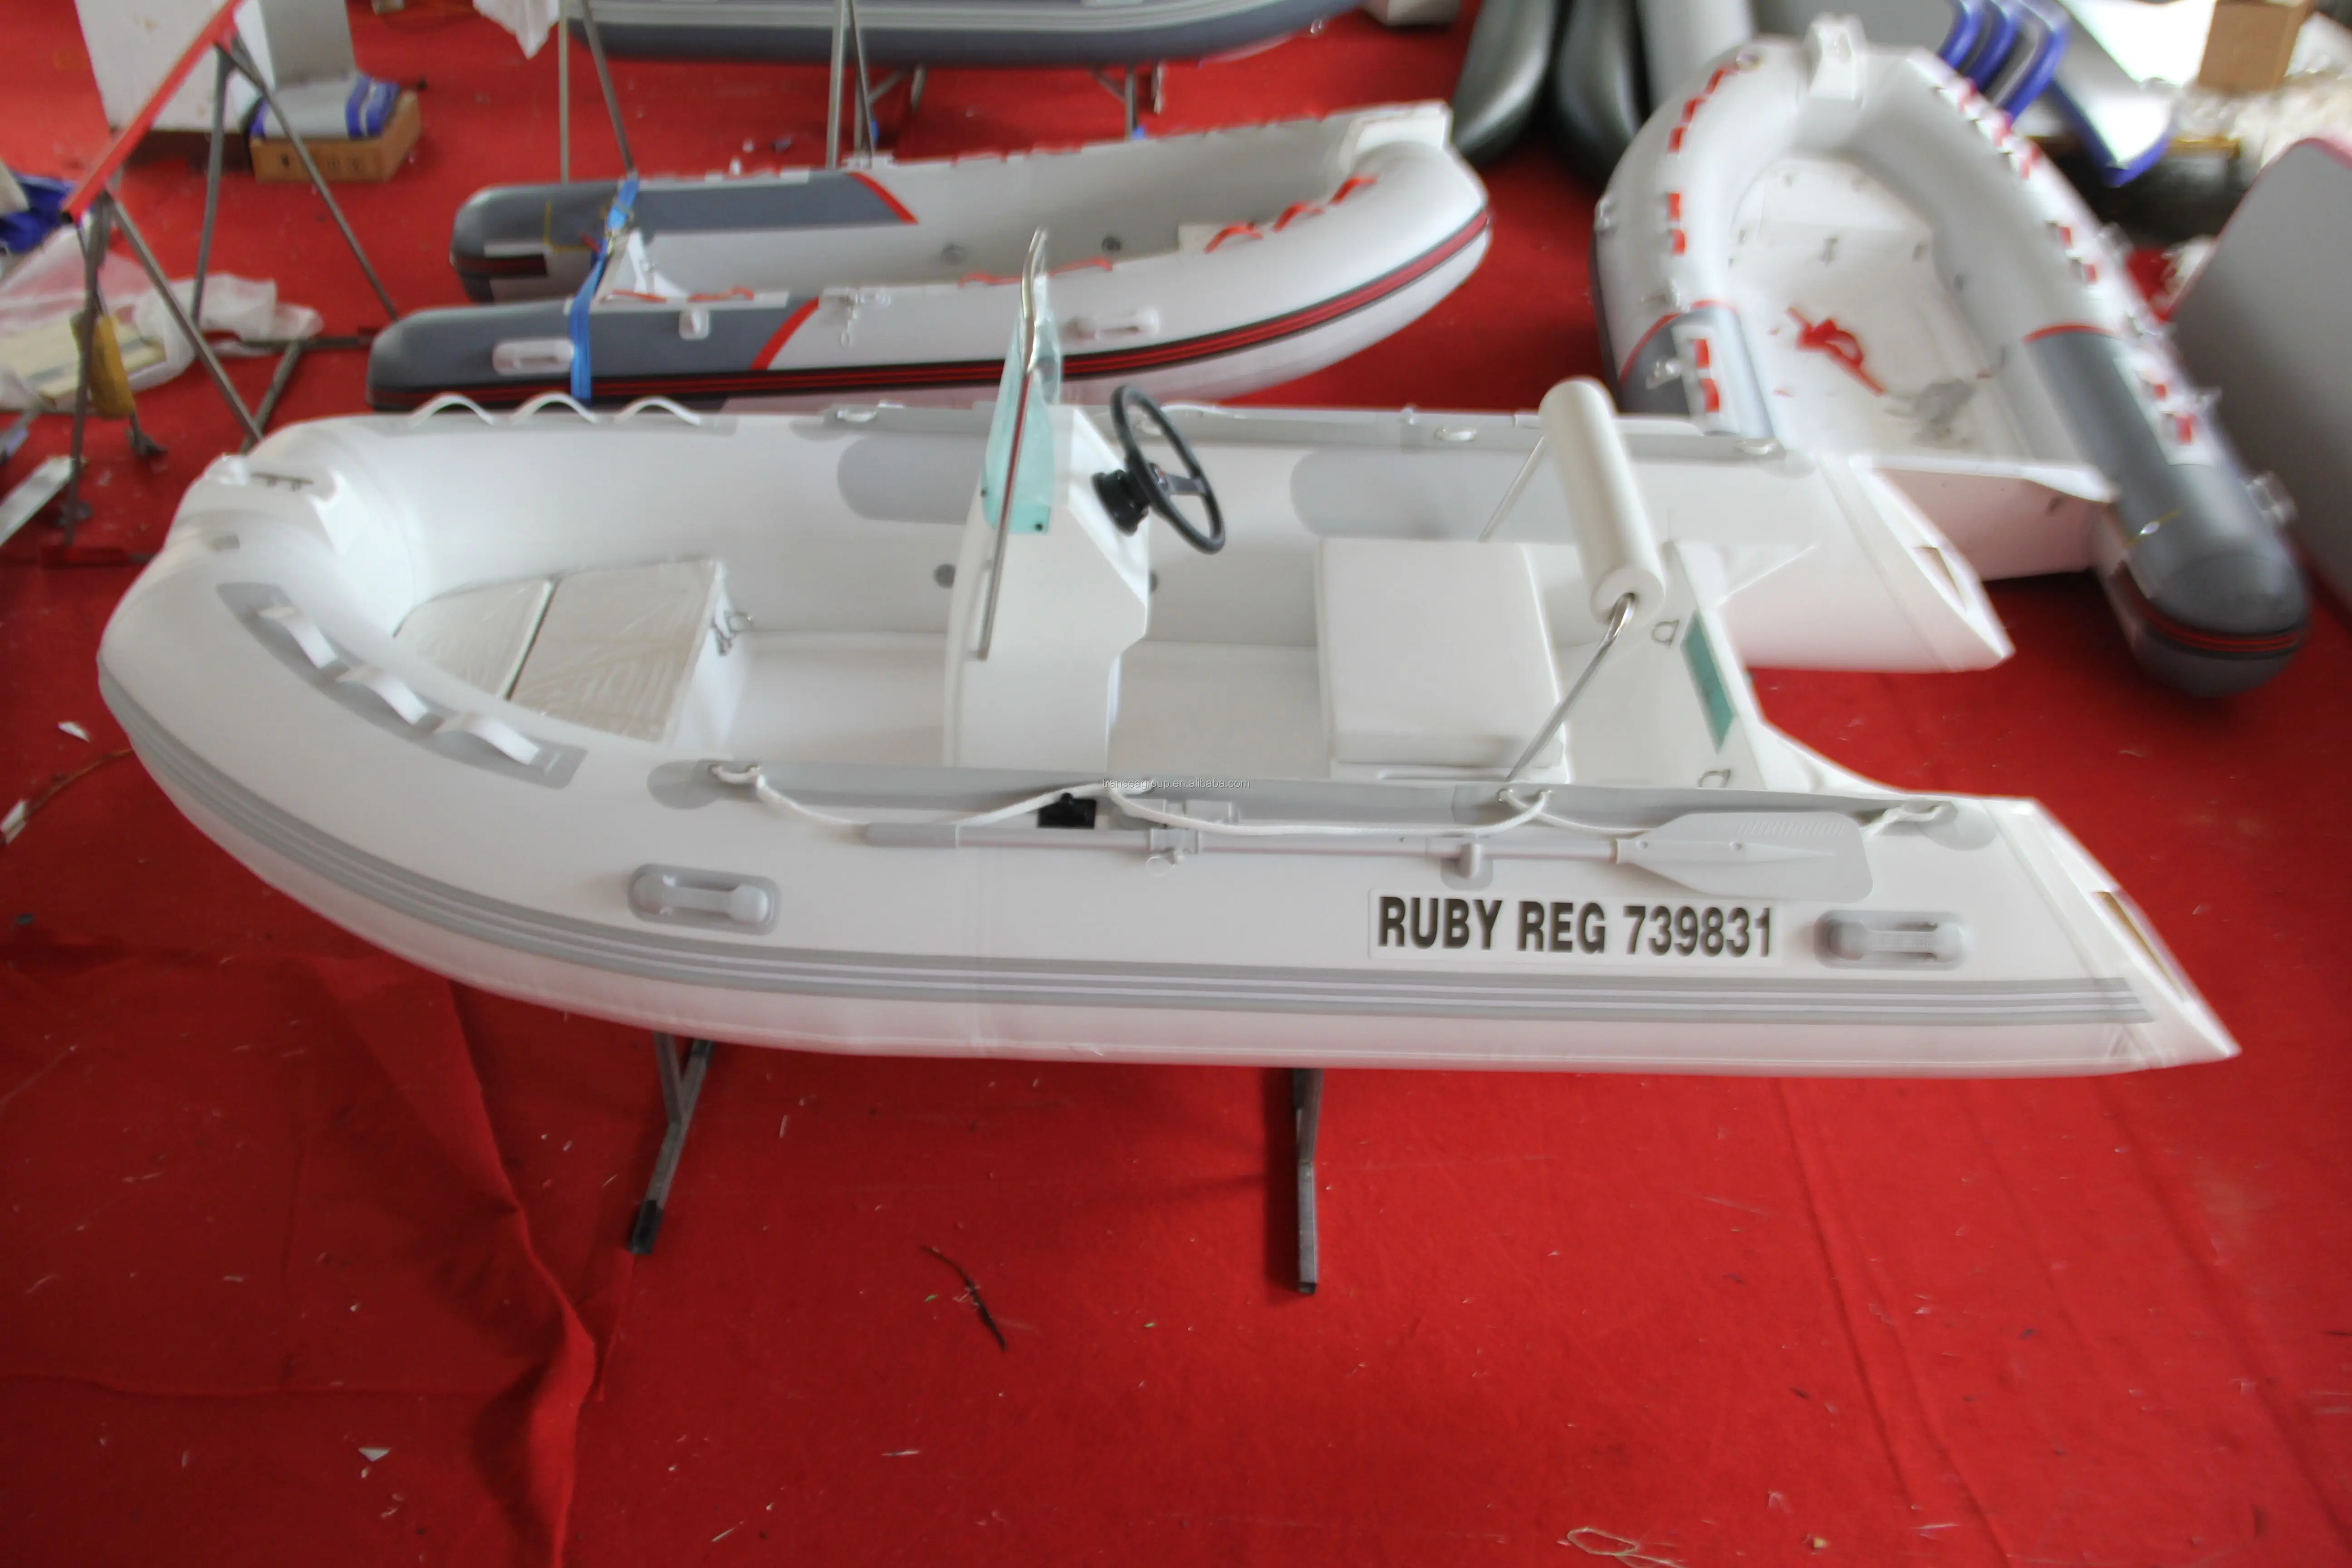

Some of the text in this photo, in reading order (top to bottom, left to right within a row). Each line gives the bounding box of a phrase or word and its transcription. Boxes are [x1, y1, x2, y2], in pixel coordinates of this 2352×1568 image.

[1378, 896, 1771, 957] RUBY REG 739831
